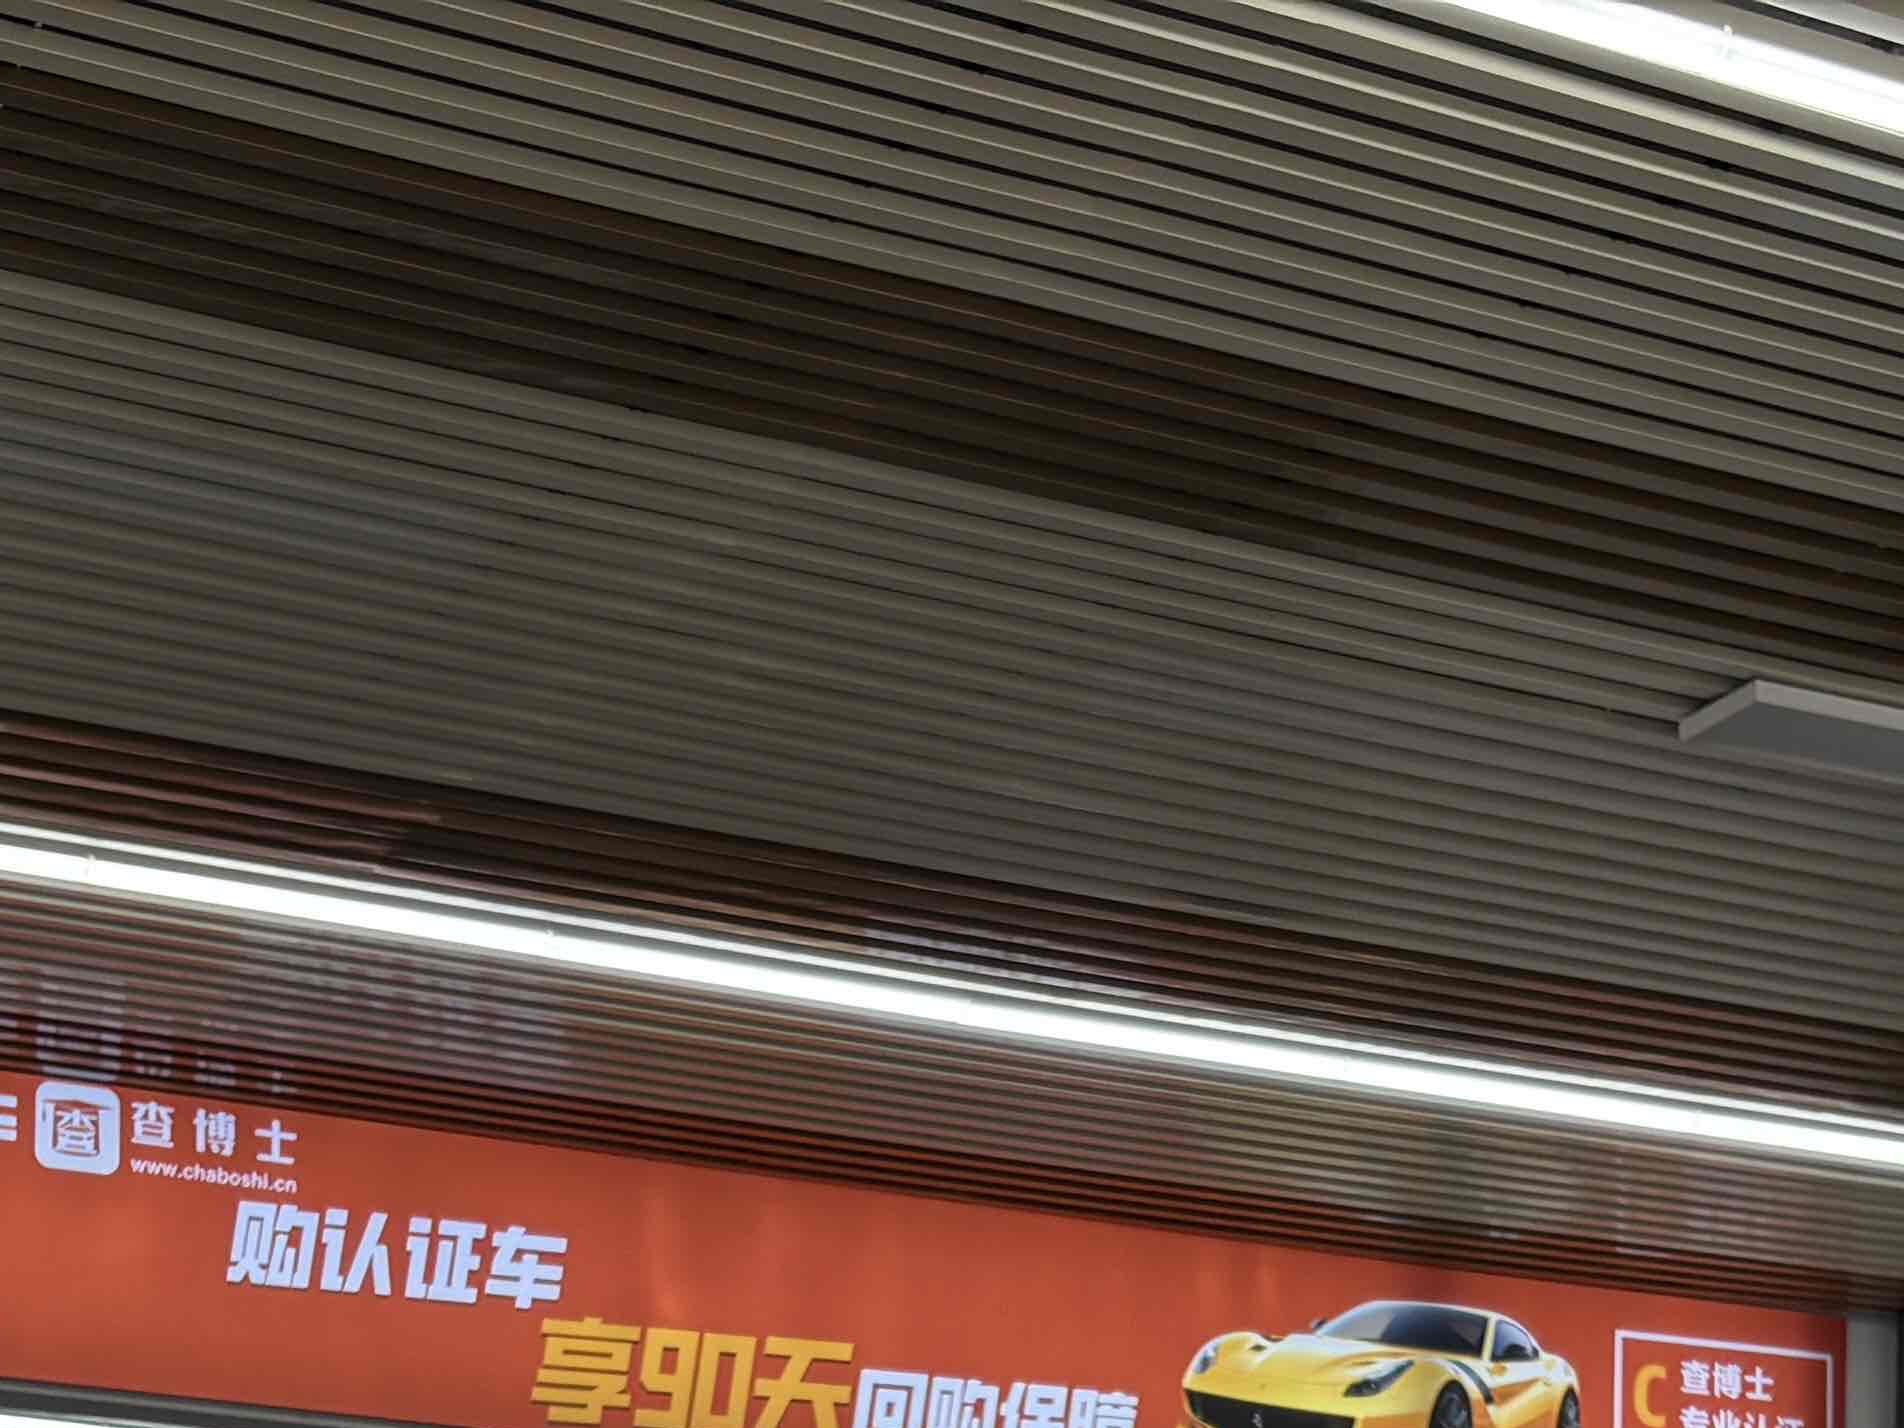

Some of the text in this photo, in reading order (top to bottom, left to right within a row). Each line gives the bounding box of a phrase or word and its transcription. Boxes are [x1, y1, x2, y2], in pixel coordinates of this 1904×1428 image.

[130, 1100, 298, 1165] 查博士
[130, 1157, 298, 1194] www.chaboshi.cn
[225, 1199, 569, 1310] 购认证车
[1679, 1359, 1774, 1402] 查博士
